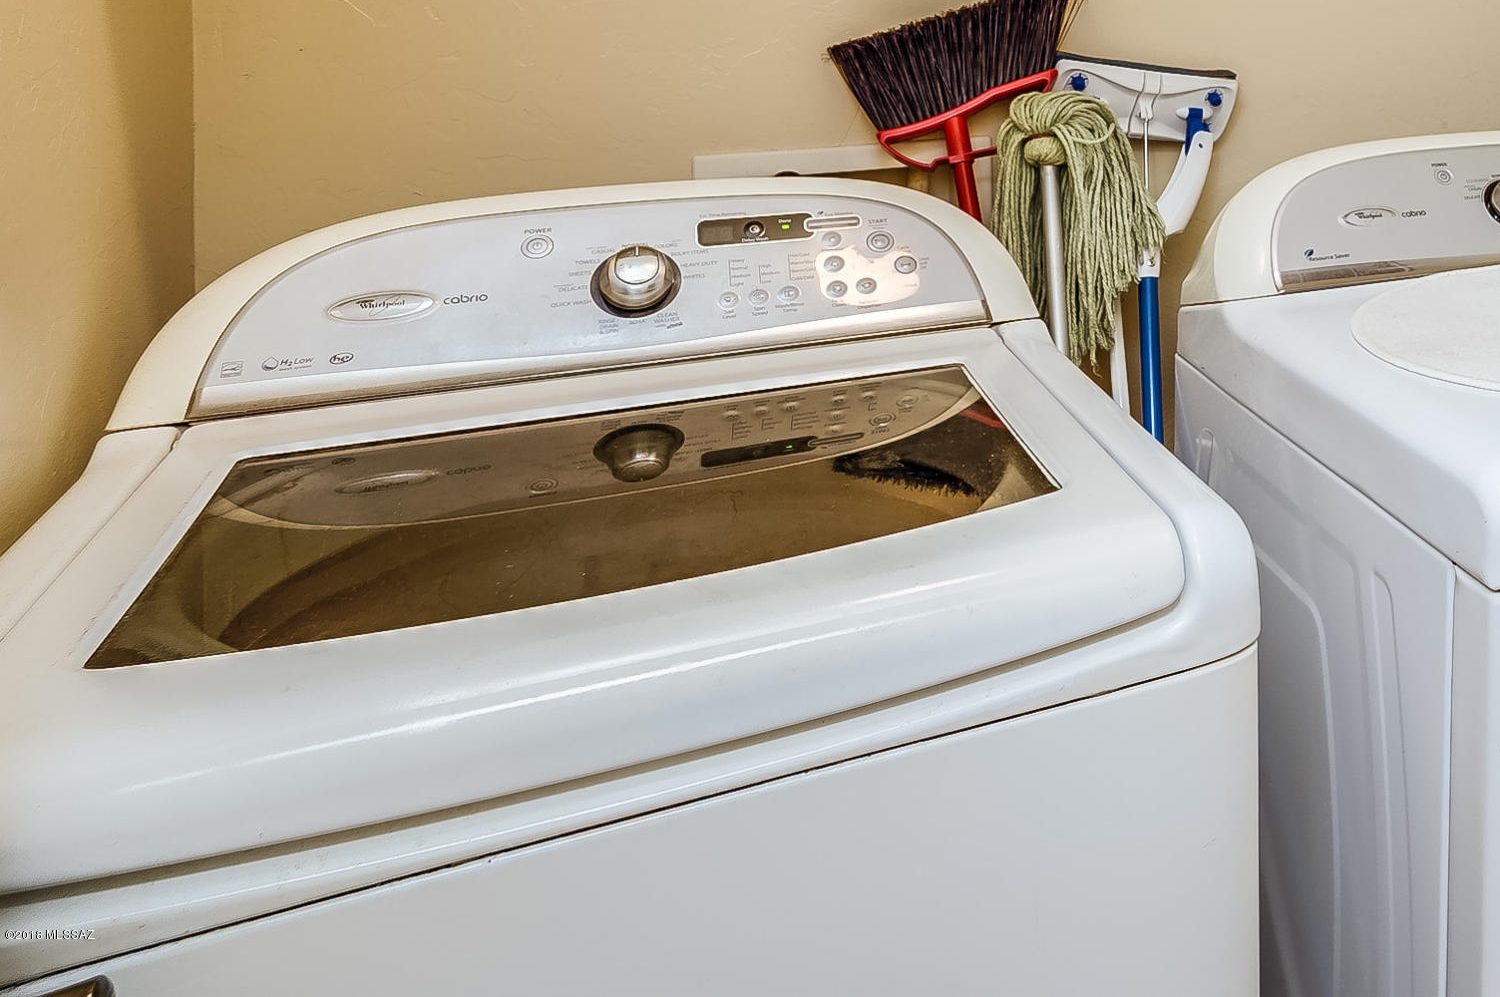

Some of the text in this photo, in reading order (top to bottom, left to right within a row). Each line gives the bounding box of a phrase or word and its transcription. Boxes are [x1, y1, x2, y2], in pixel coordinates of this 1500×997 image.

[524, 227, 552, 235] POWER
[359, 293, 489, 312] Whirlpool cabrio
